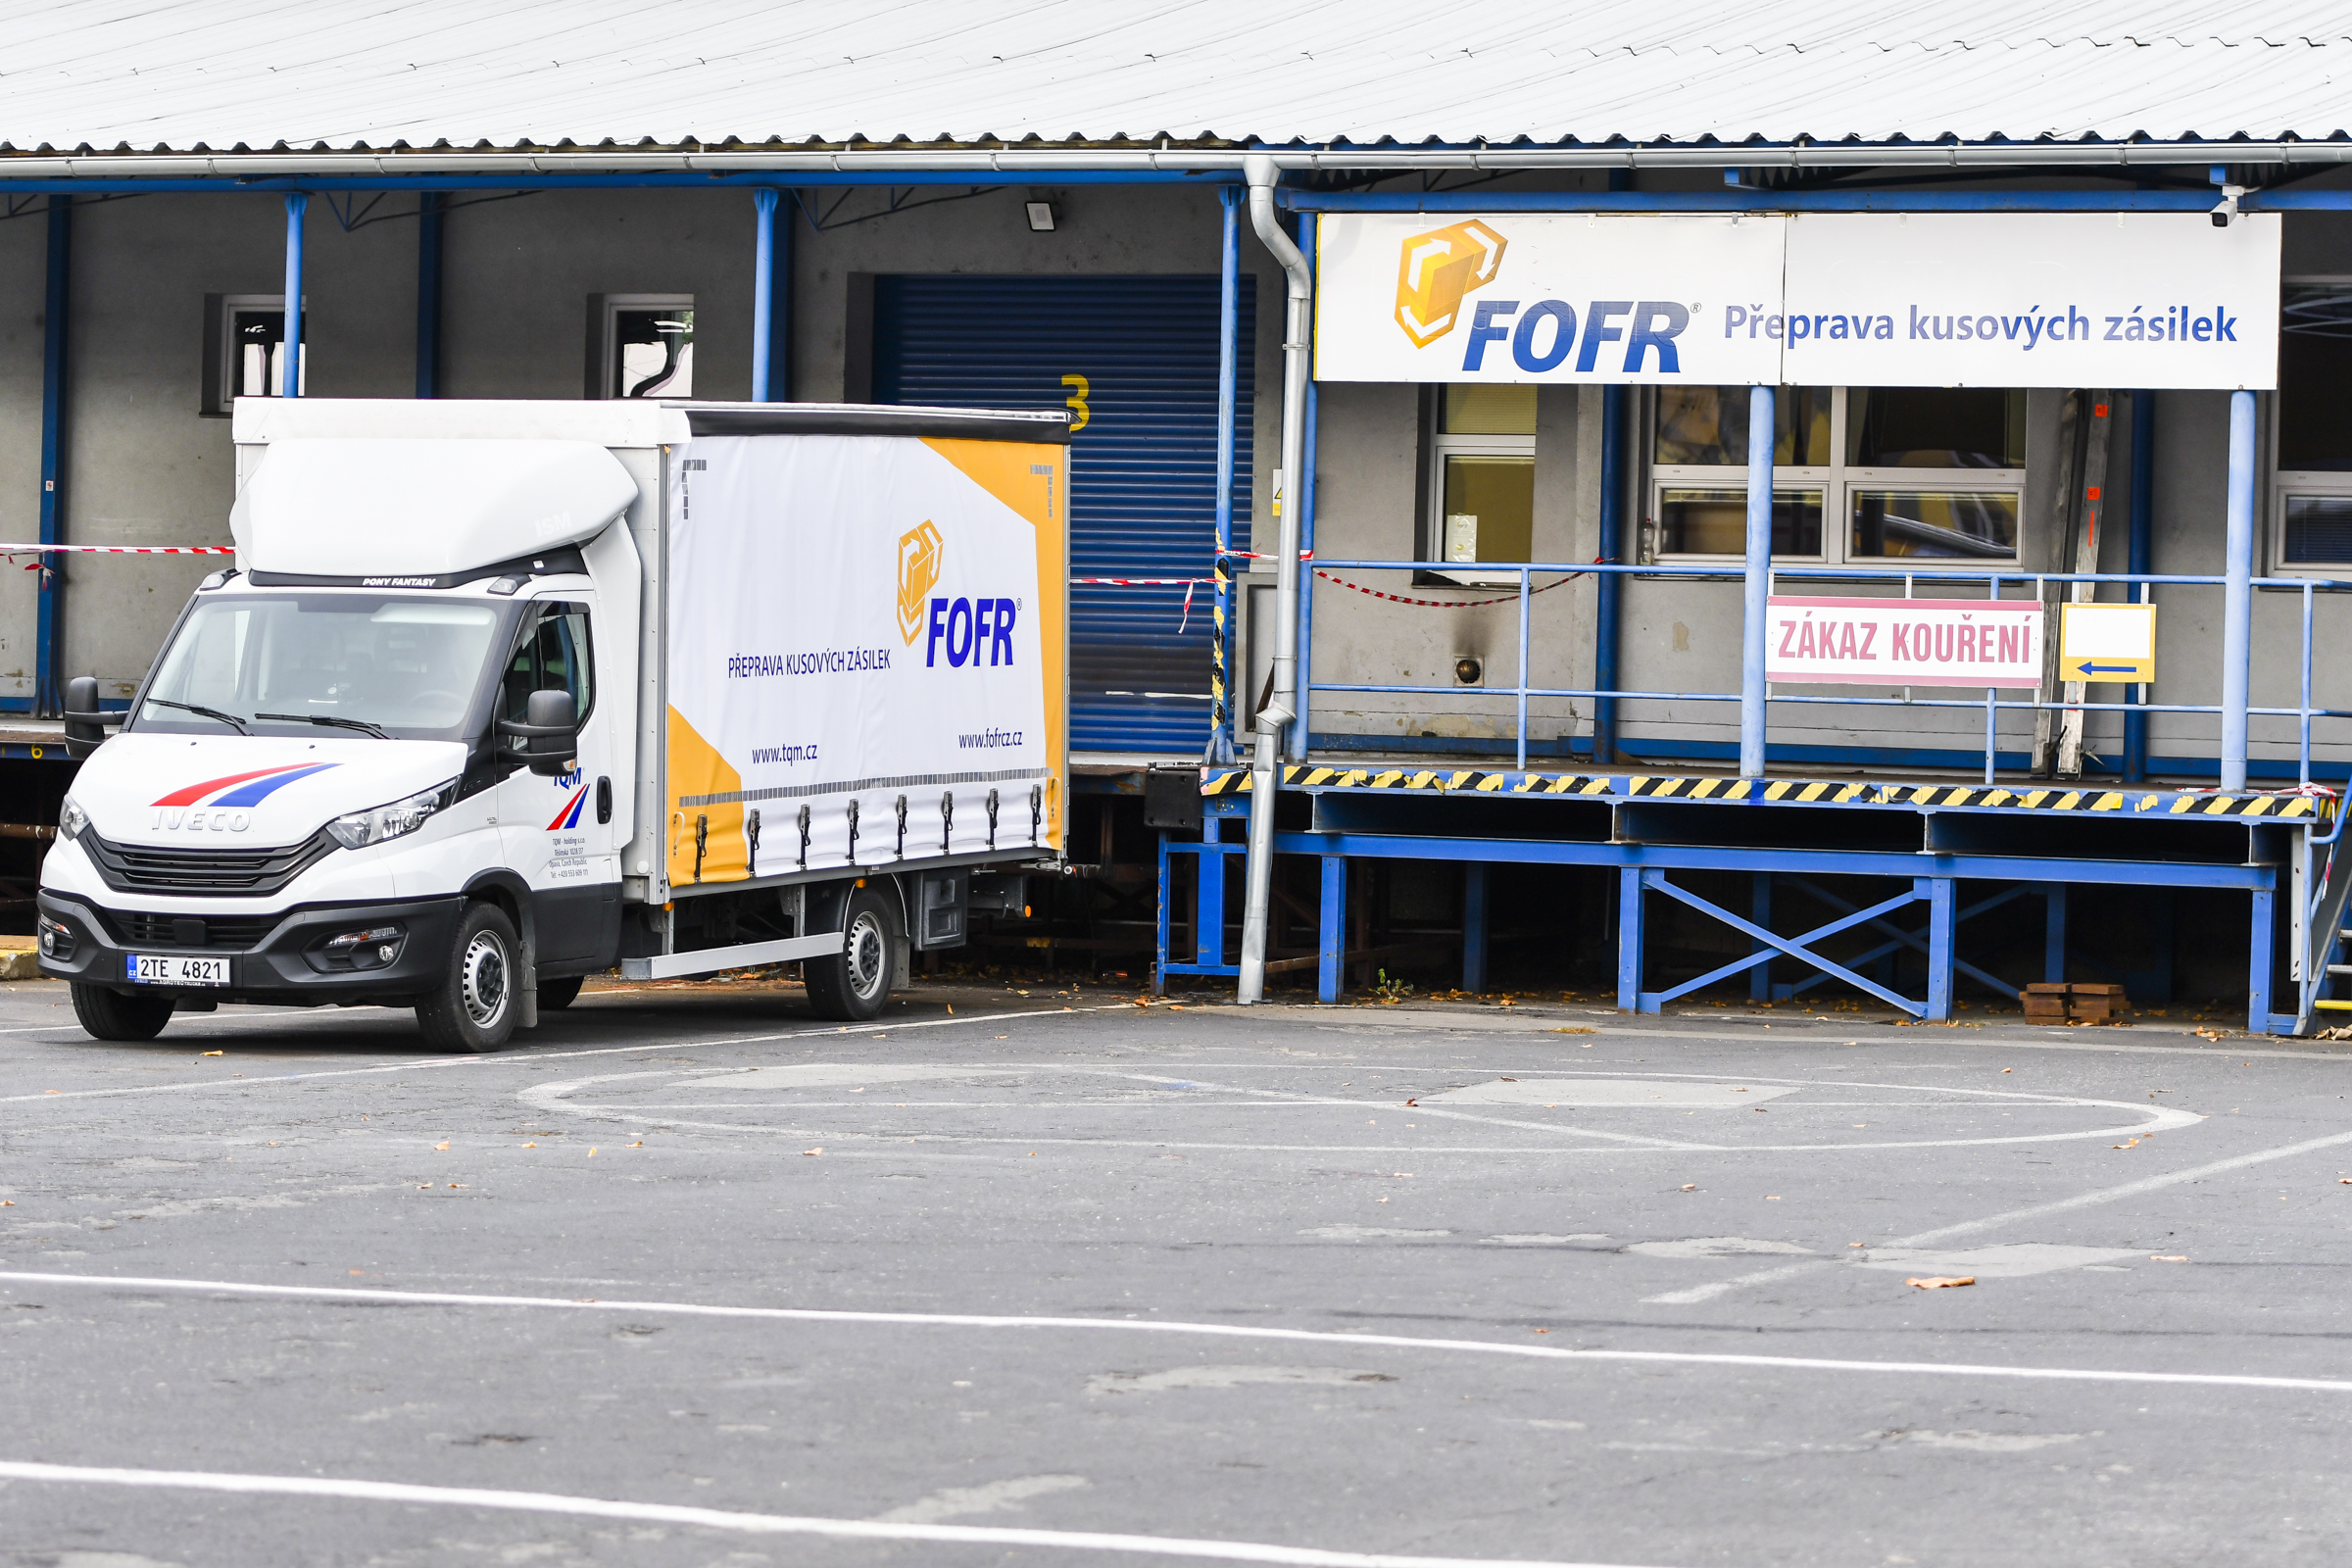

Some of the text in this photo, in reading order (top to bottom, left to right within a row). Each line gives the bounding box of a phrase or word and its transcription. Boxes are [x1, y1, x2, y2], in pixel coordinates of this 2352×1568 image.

[1725, 304, 2238, 352] Přeprava kusových zásilek
[1061, 373, 1090, 431] 3
[534, 511, 572, 538] ISM
[363, 577, 436, 587] PONY FANTASY
[1779, 611, 2033, 663] ZÁKAZ KOUŘENÍ
[728, 646, 891, 679] PŘEPRAVA KUSOVÝCH ZÁSILEK
[958, 727, 1023, 750] www.fofrcz.cz
[752, 743, 817, 767] www.tqm.cz
[152, 808, 251, 832] IVECO
[140, 958, 221, 980] 2TE 4821
